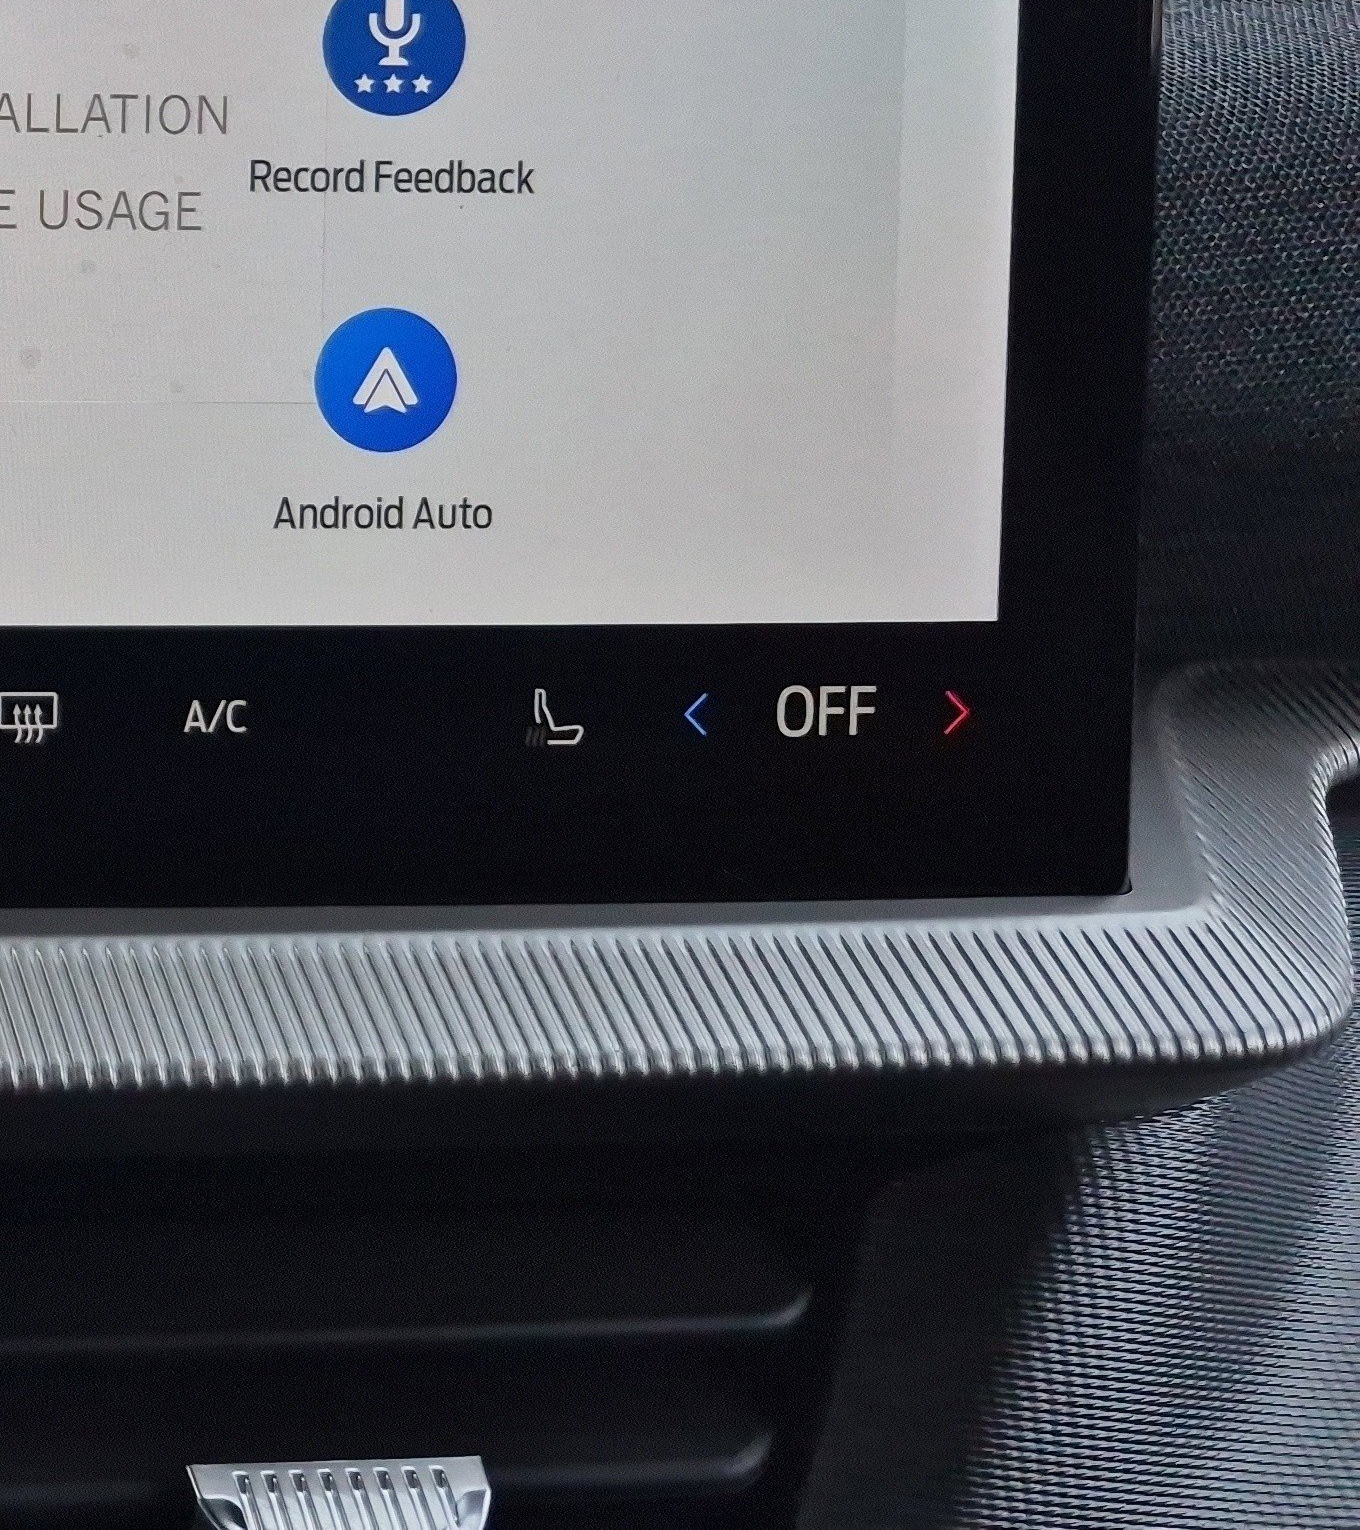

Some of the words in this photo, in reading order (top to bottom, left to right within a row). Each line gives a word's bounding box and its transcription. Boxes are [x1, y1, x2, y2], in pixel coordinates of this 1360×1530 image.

[250, 159, 364, 192] Record
[375, 160, 534, 194] Feedback
[40, 190, 202, 231] USAGE
[273, 496, 404, 529] Android
[412, 497, 492, 529] Auto
[185, 700, 246, 732] A/C
[778, 686, 876, 737] OFF
